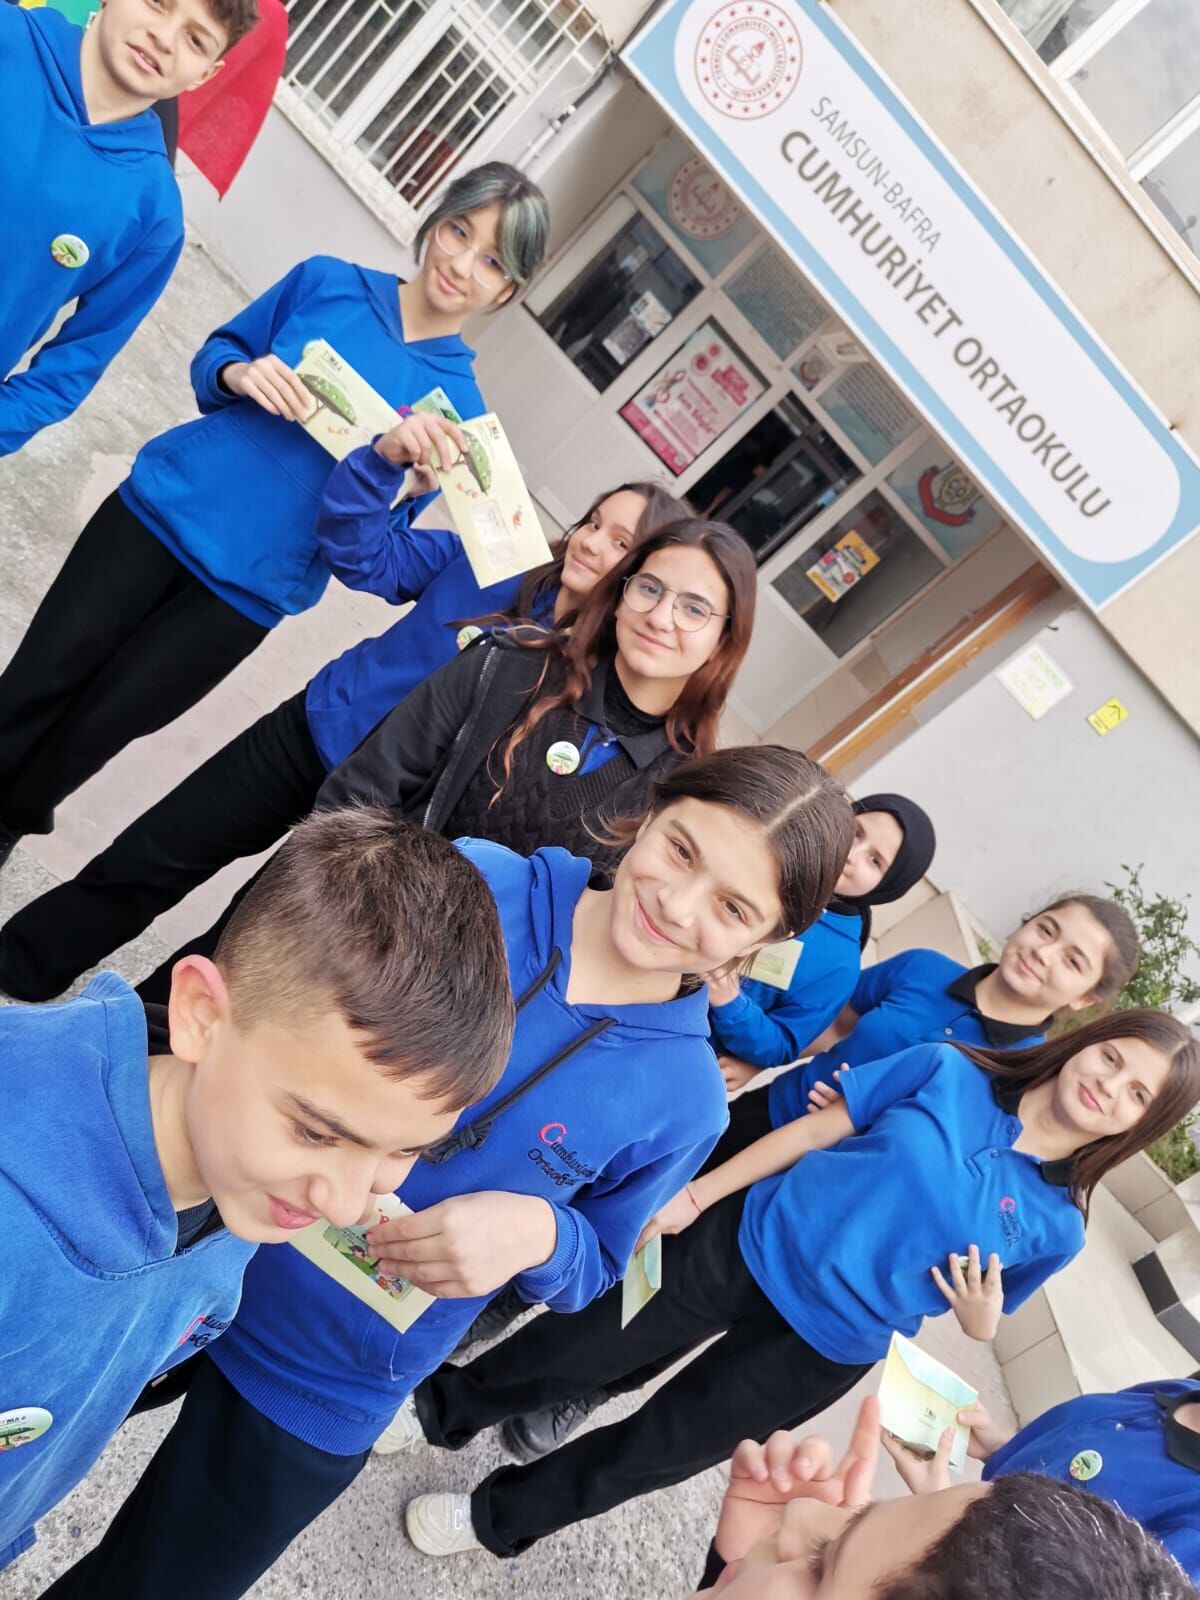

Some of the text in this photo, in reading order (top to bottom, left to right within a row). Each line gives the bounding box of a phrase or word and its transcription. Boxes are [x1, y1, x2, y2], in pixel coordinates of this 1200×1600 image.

[810, 96, 941, 253] SAMSUN-BAFRA
[780, 131, 963, 338] CUMHURİYET
[953, 337, 1112, 518] ORTAOKULU
